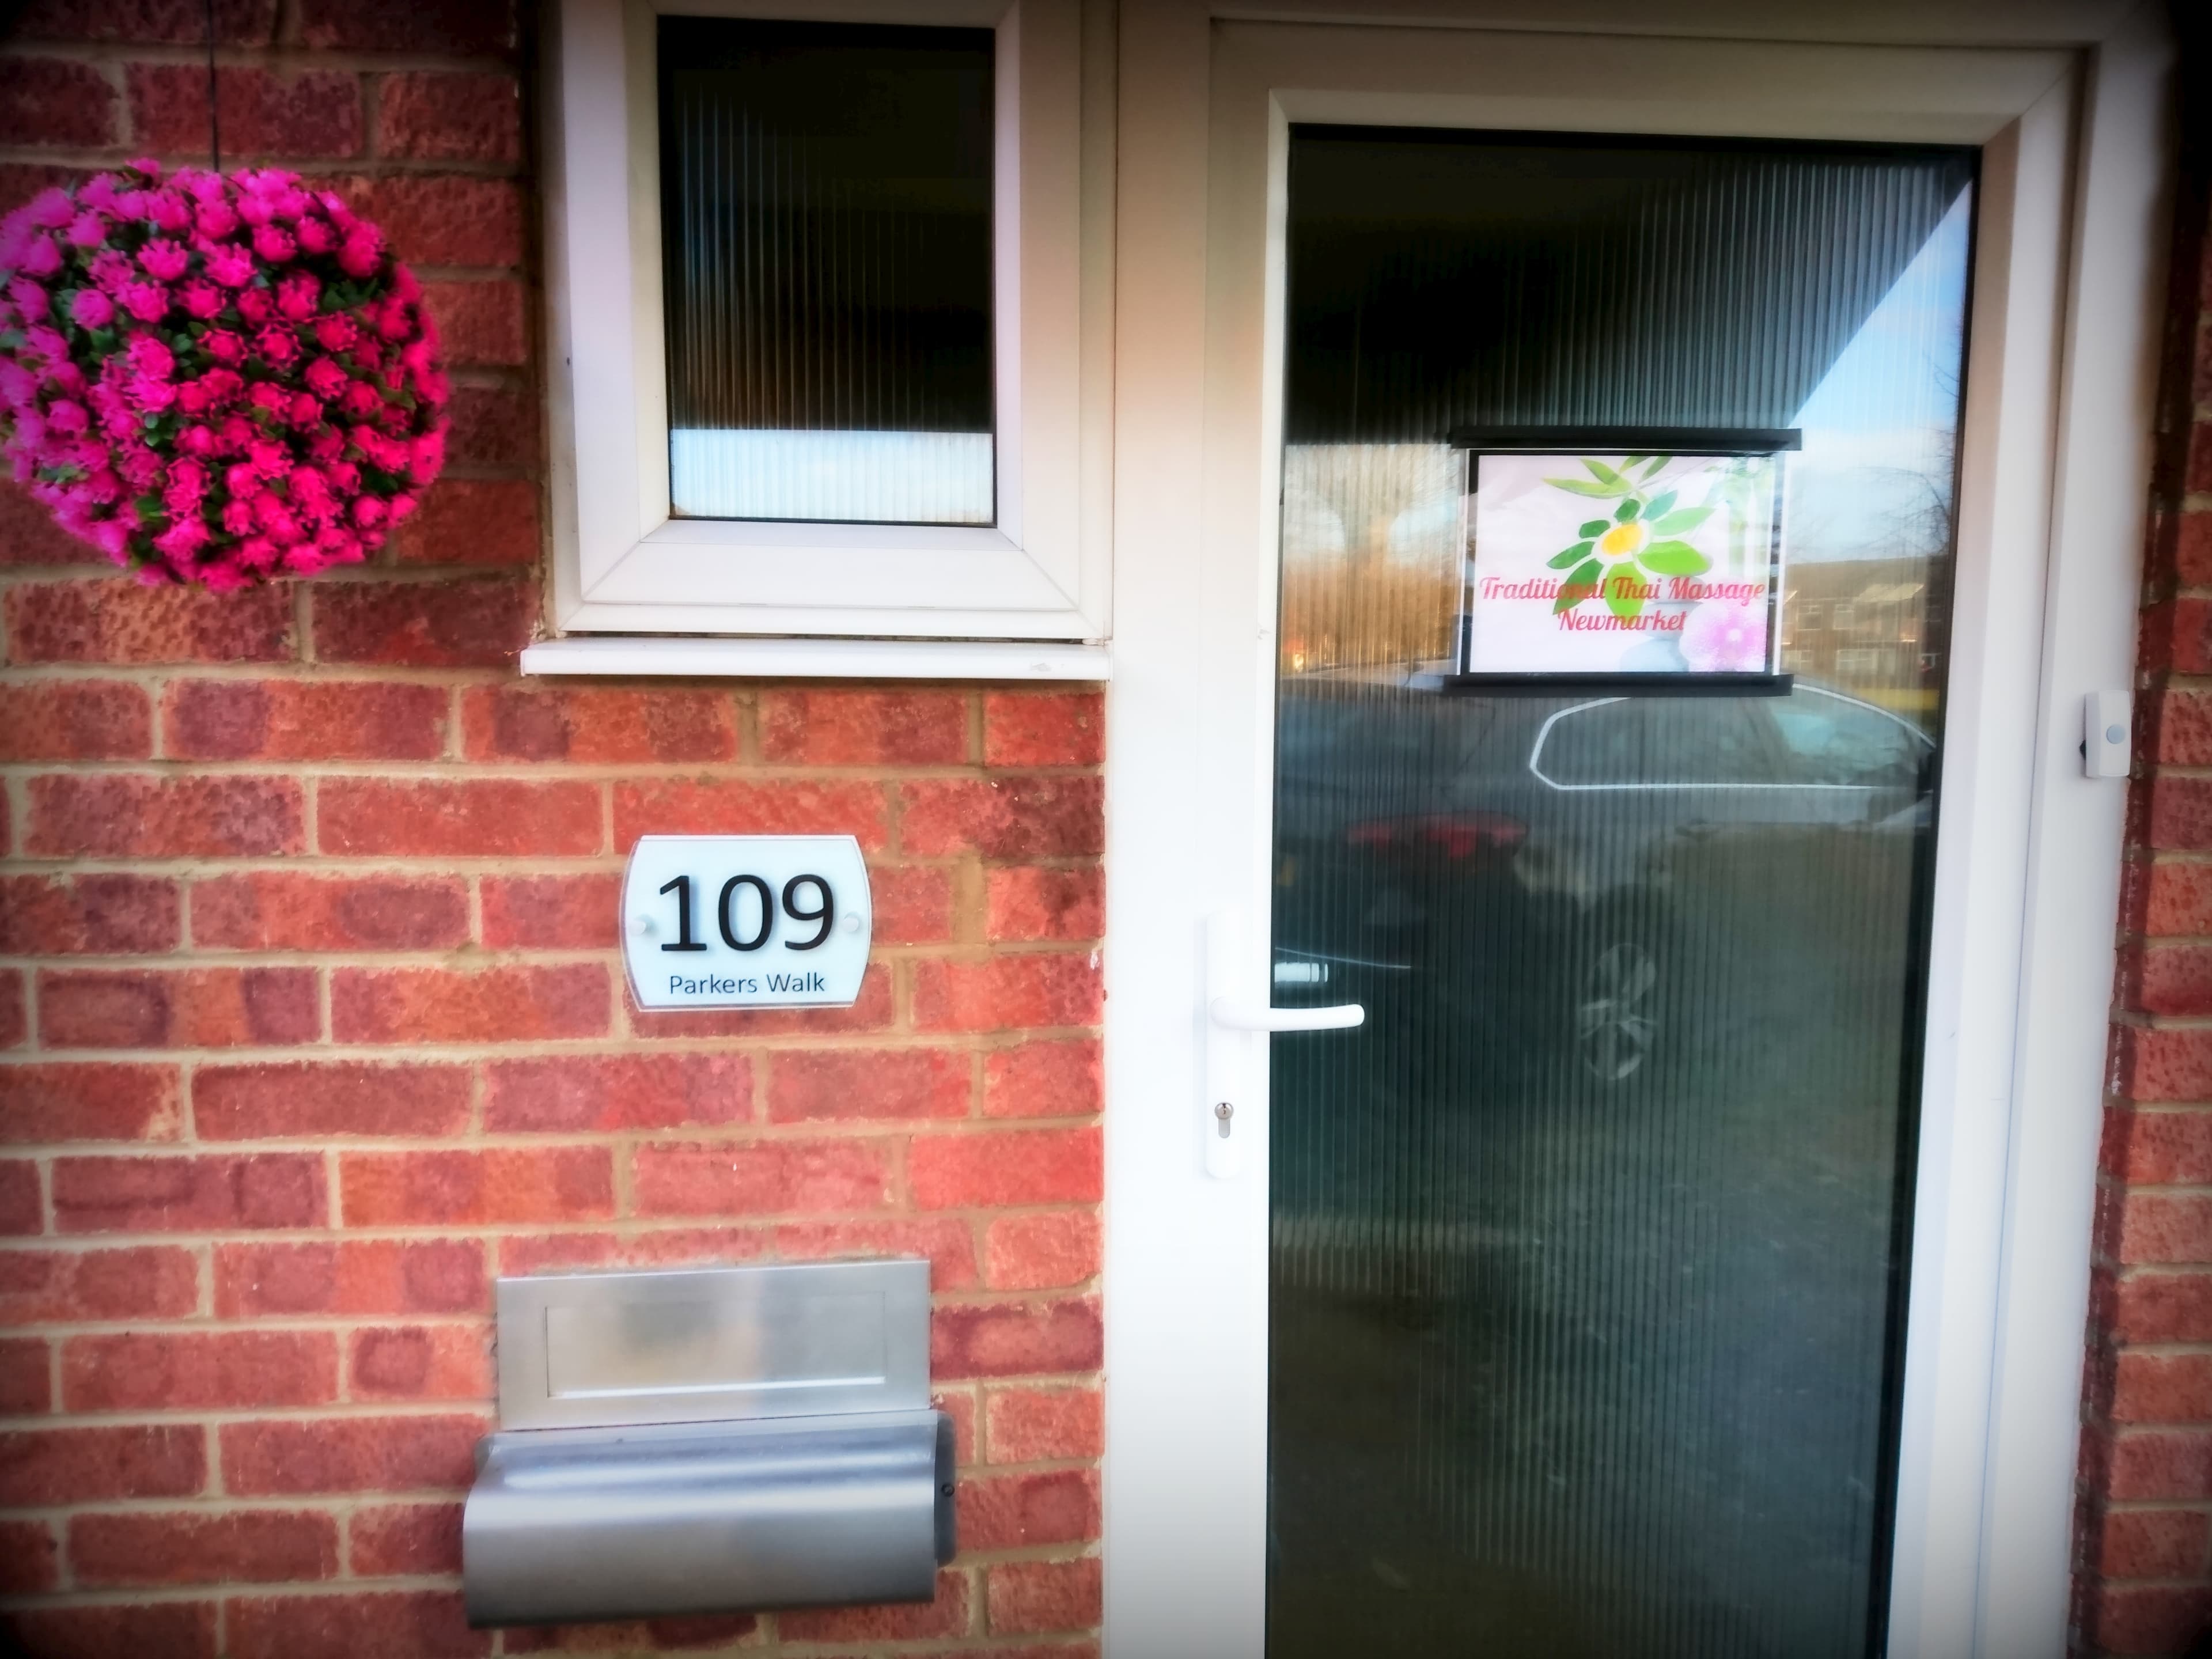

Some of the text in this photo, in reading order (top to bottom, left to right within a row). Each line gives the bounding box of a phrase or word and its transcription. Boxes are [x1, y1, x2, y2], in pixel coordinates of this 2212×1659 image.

[1479, 577, 1765, 607] Traditional Thai Massage
[1558, 608, 1687, 631] Newmarket
[660, 874, 834, 952] 109
[670, 972, 825, 994] Parkers Walk
